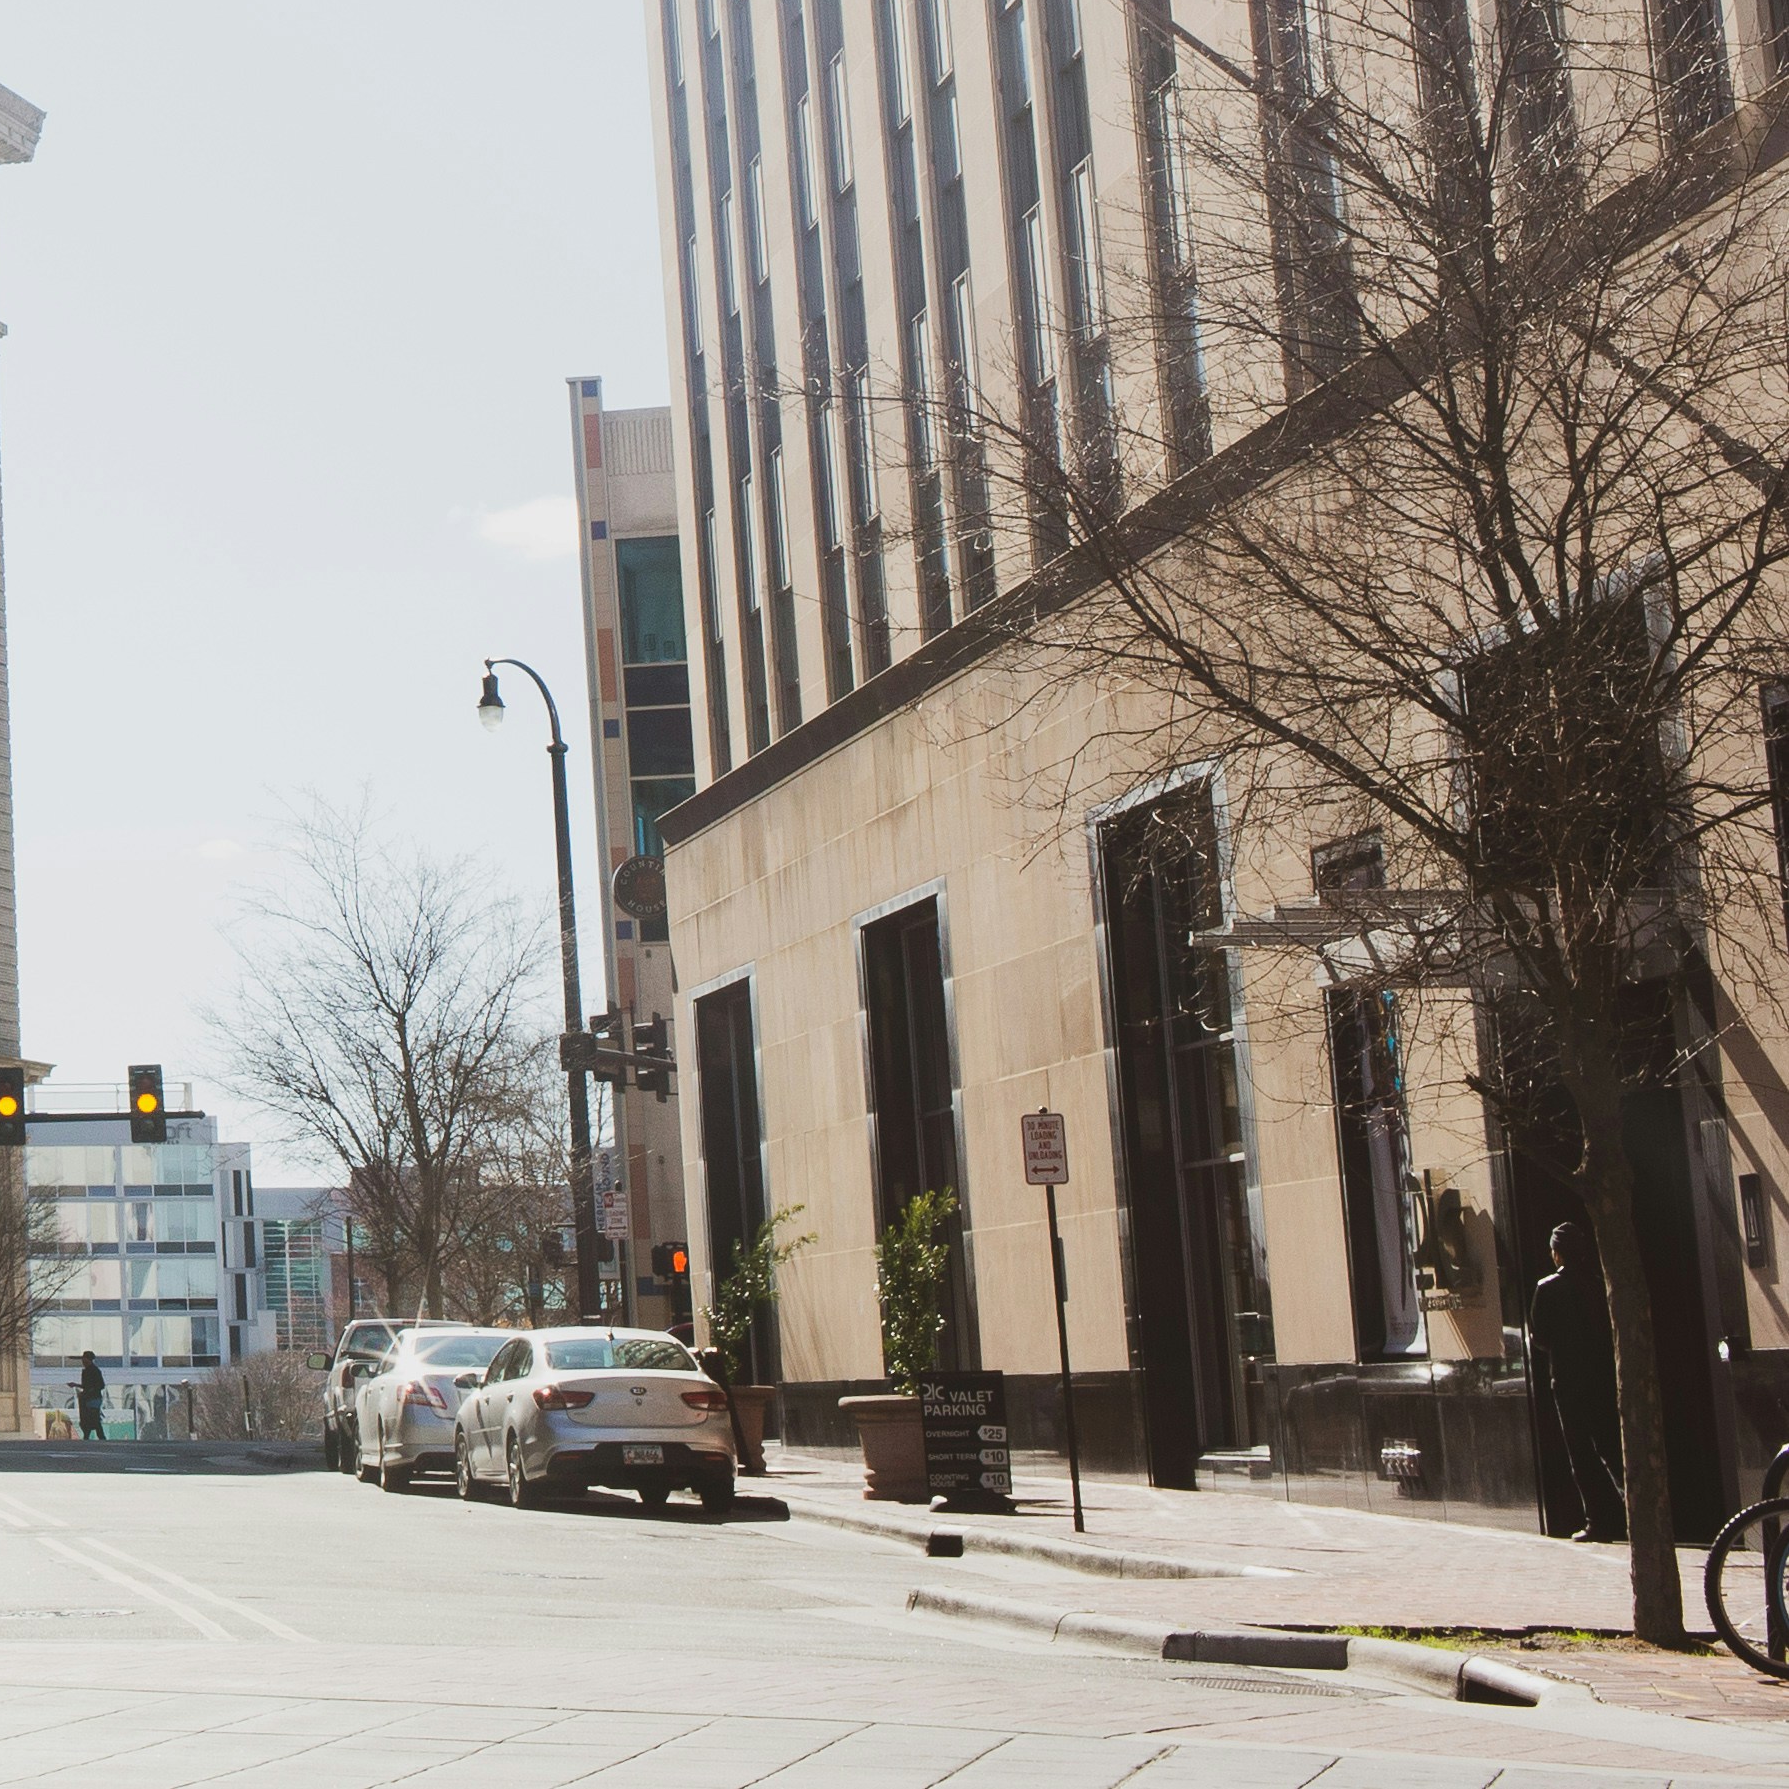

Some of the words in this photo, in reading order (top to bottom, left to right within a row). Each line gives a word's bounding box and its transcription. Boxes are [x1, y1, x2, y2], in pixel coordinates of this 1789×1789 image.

[1038, 1140, 1051, 1150] AND
[949, 1391, 994, 1403] VALET
[924, 1404, 987, 1416] PARKING
[925, 1430, 970, 1438] OVERNIGHT
[983, 1428, 1003, 1440] $25
[927, 1453, 953, 1461] SHORT
[984, 1451, 1004, 1462] $10
[985, 1474, 1005, 1486] $10
